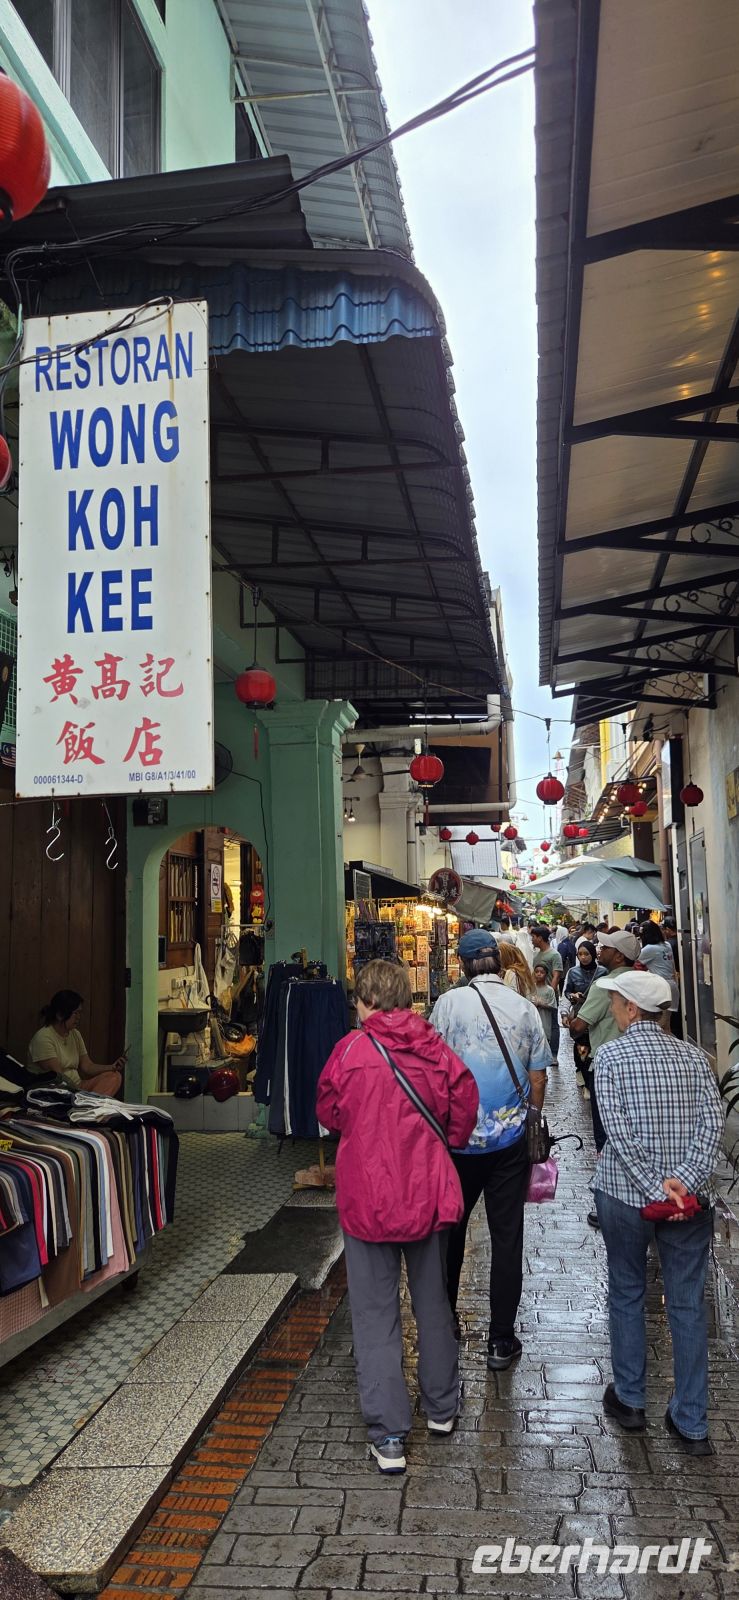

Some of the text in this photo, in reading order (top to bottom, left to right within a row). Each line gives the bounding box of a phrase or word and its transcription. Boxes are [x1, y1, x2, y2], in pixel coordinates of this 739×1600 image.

[35, 331, 193, 392] RESTORAN
[50, 400, 180, 471] WONG
[68, 485, 159, 551] KOH
[67, 568, 153, 634] KEE
[56, 717, 163, 766] 飯店
[33, 774, 84, 785] 000061344-D
[128, 772, 143, 782] MBI
